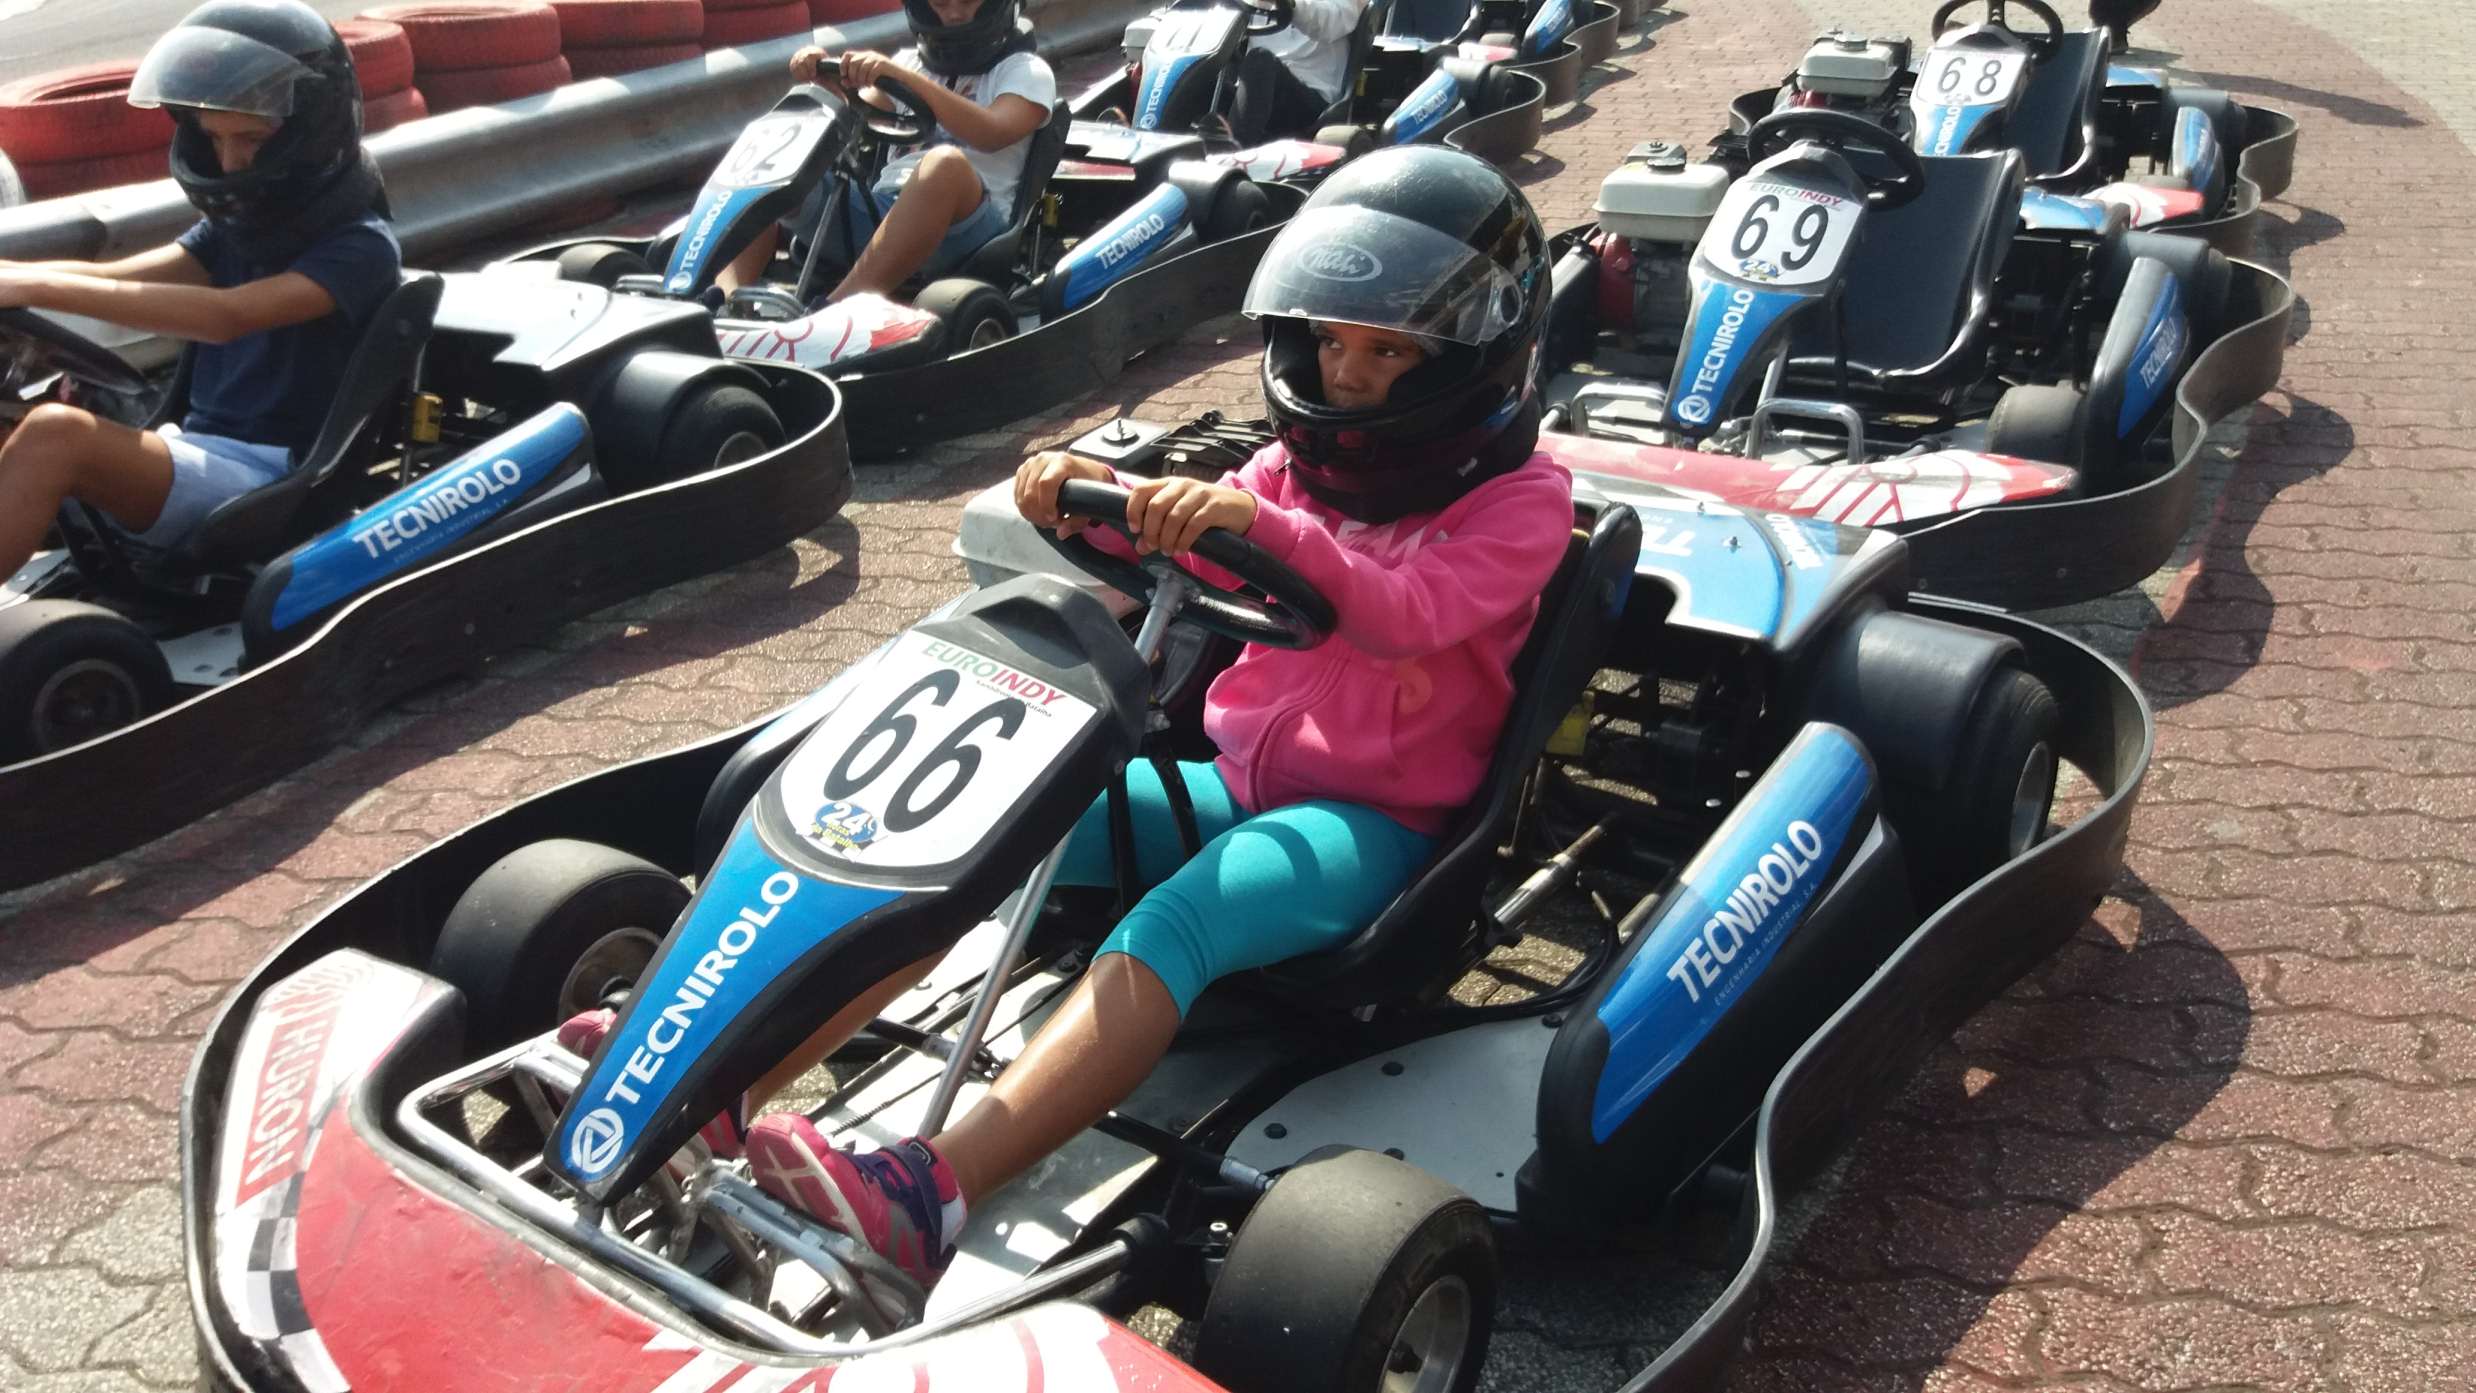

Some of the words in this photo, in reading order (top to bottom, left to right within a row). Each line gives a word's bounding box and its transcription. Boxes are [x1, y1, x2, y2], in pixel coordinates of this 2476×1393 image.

[1938, 57, 2002, 96] 68
[730, 123, 802, 174] 62
[679, 189, 733, 272] TECNIROLO
[1731, 194, 1829, 271] 69
[1750, 183, 1842, 206] EUROINDY
[1095, 213, 1165, 270] TECNIROLO
[1691, 290, 1755, 393] TECNIROLO
[352, 458, 521, 559] TECNIROLO
[922, 642, 1067, 706] EUROINDY
[823, 669, 1027, 833] 66
[820, 801, 873, 836] 24
[1667, 820, 1822, 1003] TECNIROLO
[606, 871, 799, 1104] TECNIROLO
